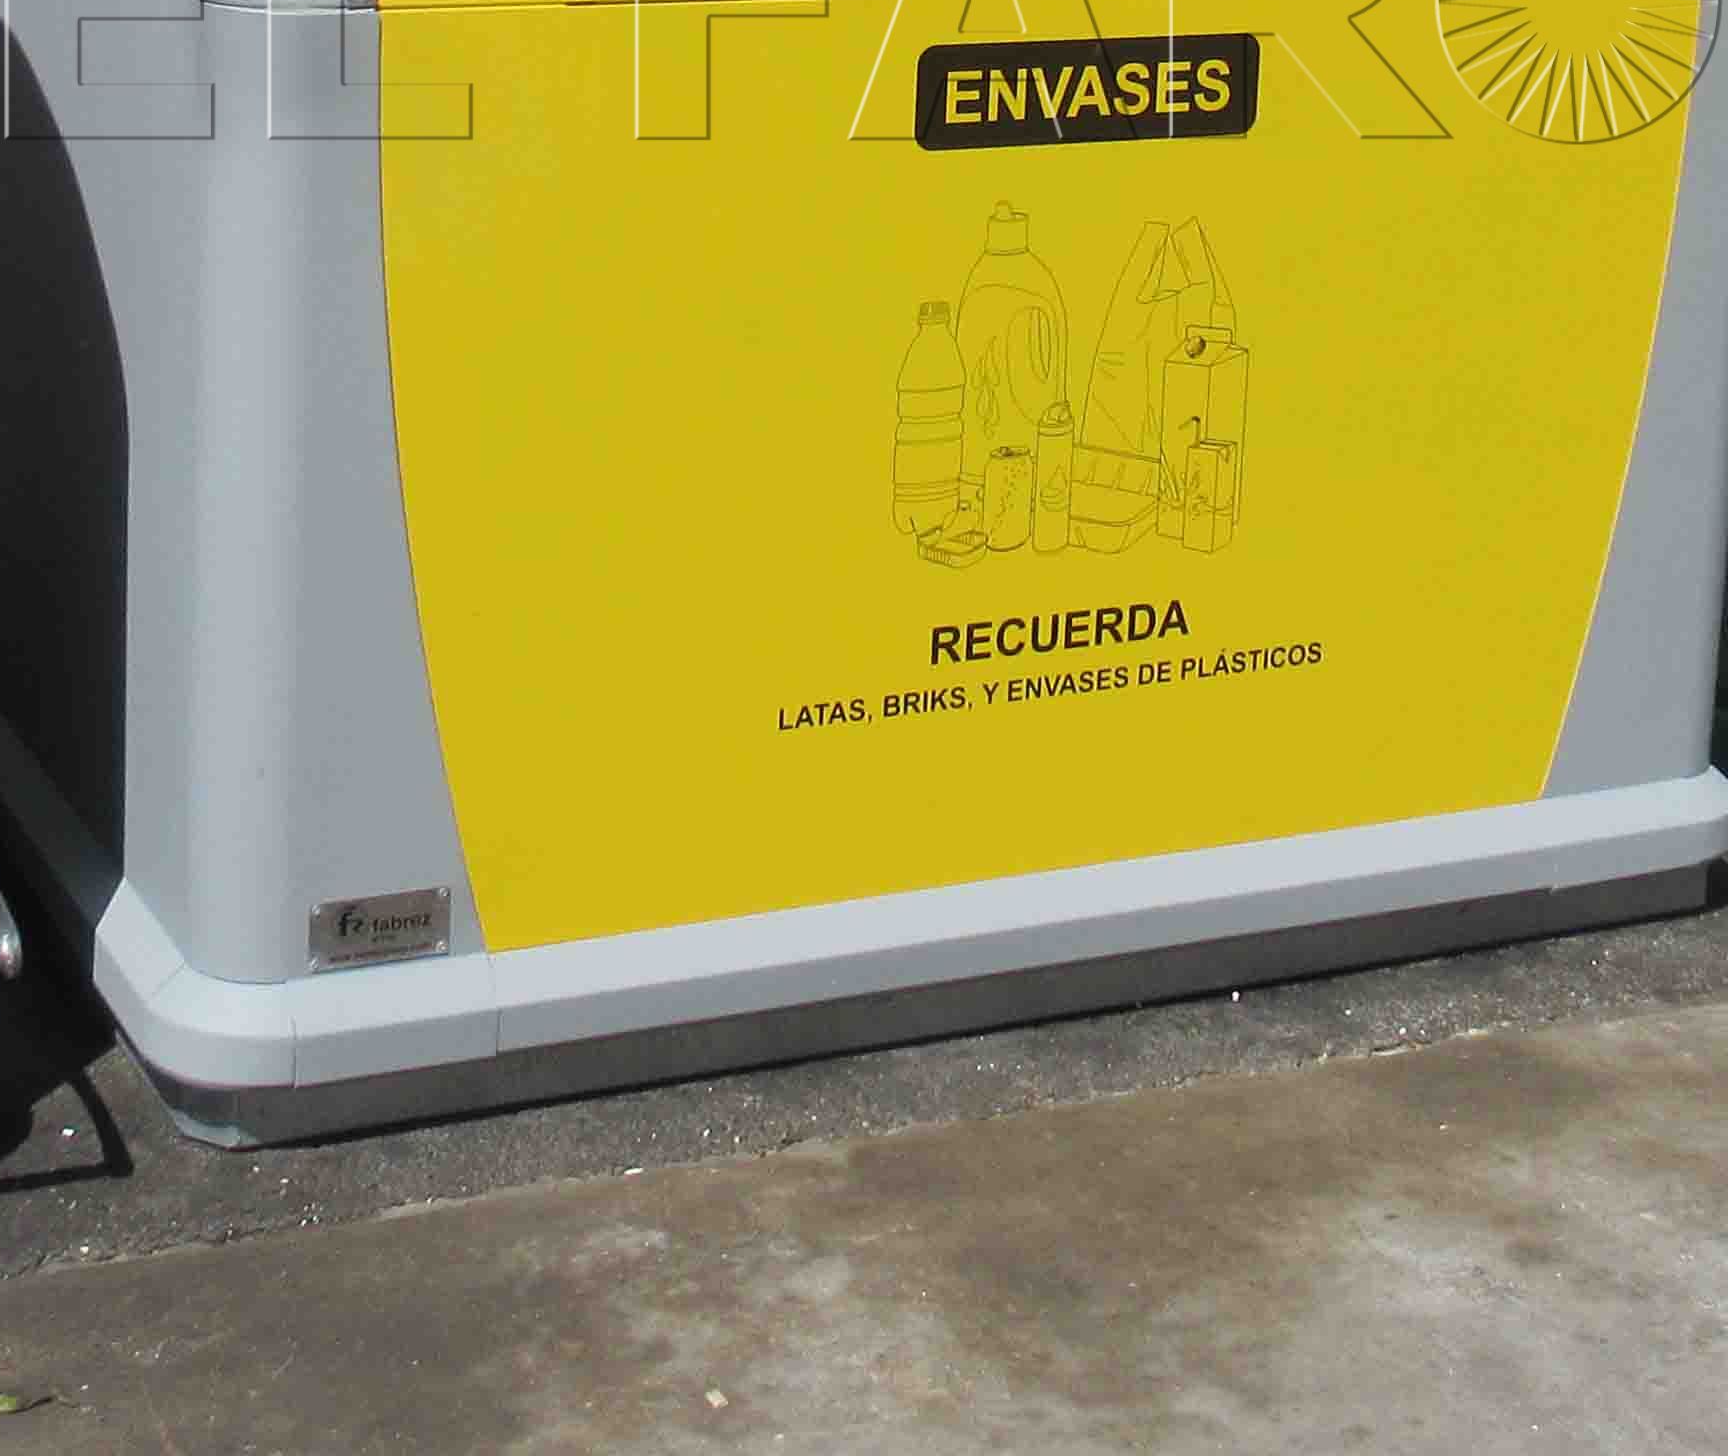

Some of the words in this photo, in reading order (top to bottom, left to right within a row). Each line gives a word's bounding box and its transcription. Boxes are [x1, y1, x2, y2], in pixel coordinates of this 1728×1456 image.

[944, 58, 1231, 125] ENVASES
[929, 600, 1190, 664] RECUERDA
[777, 698, 873, 732] LATAS,
[881, 685, 974, 719] BRIKS,
[982, 681, 1001, 706] Y
[1006, 666, 1130, 704] ENVASES
[1137, 660, 1173, 685] DE
[1179, 640, 1323, 681] PLÁSTICOS
